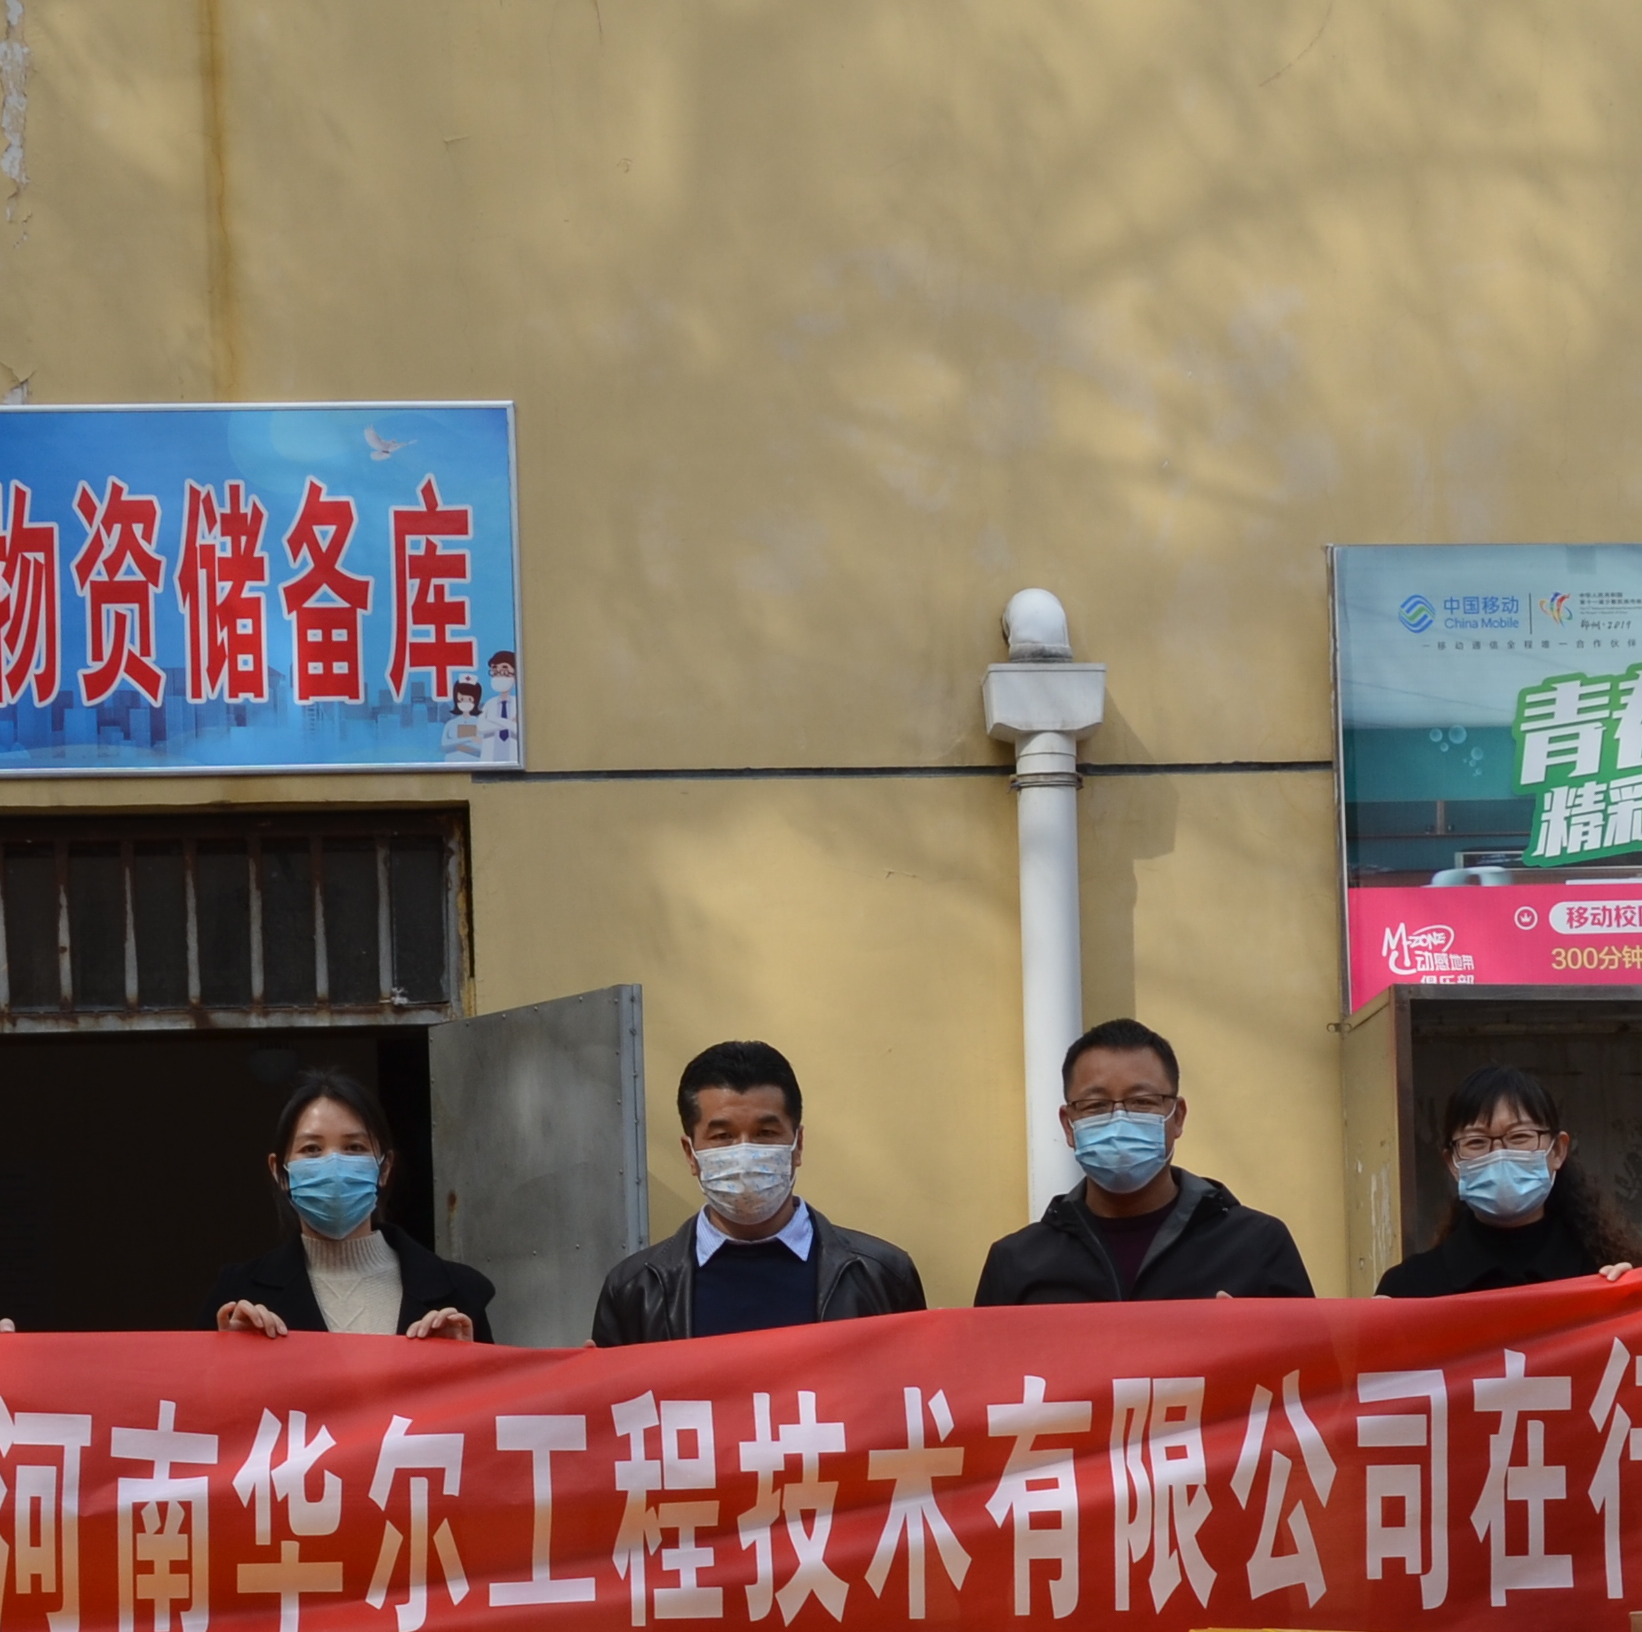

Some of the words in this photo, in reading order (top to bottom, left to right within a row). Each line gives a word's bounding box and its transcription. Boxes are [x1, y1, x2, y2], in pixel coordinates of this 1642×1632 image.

[1443, 596, 1519, 615] 中国移动
[1444, 618, 1478, 629] China
[1481, 618, 1519, 629] Mobile
